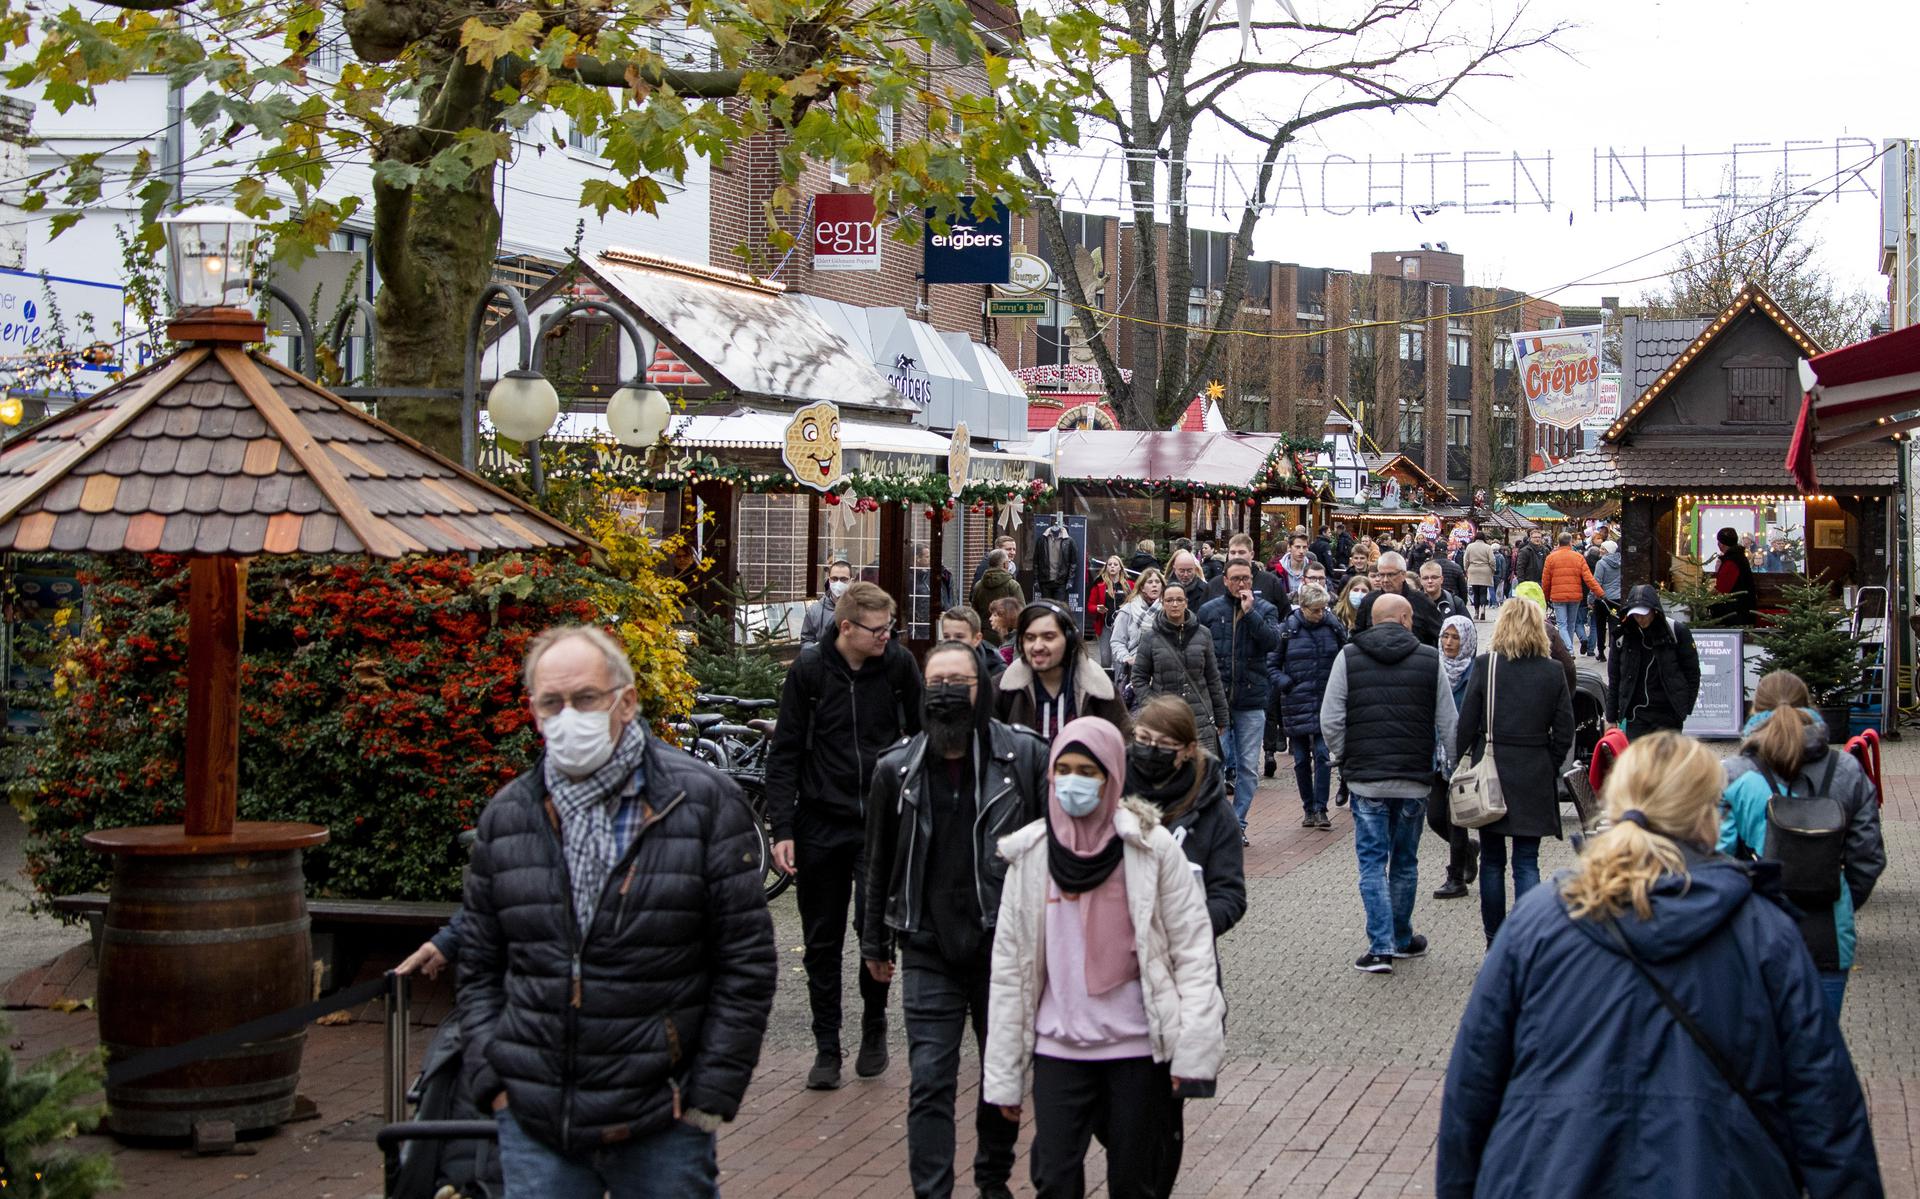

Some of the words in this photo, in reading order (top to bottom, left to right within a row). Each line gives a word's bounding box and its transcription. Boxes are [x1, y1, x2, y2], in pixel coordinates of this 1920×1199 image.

[1593, 145, 1648, 213] IN
[1681, 137, 1879, 210] LEER
[931, 231, 1003, 250] engbers
[1027, 303, 1044, 313] Pub
[0, 322, 41, 346] erie
[1526, 355, 1600, 401] Crêpes
